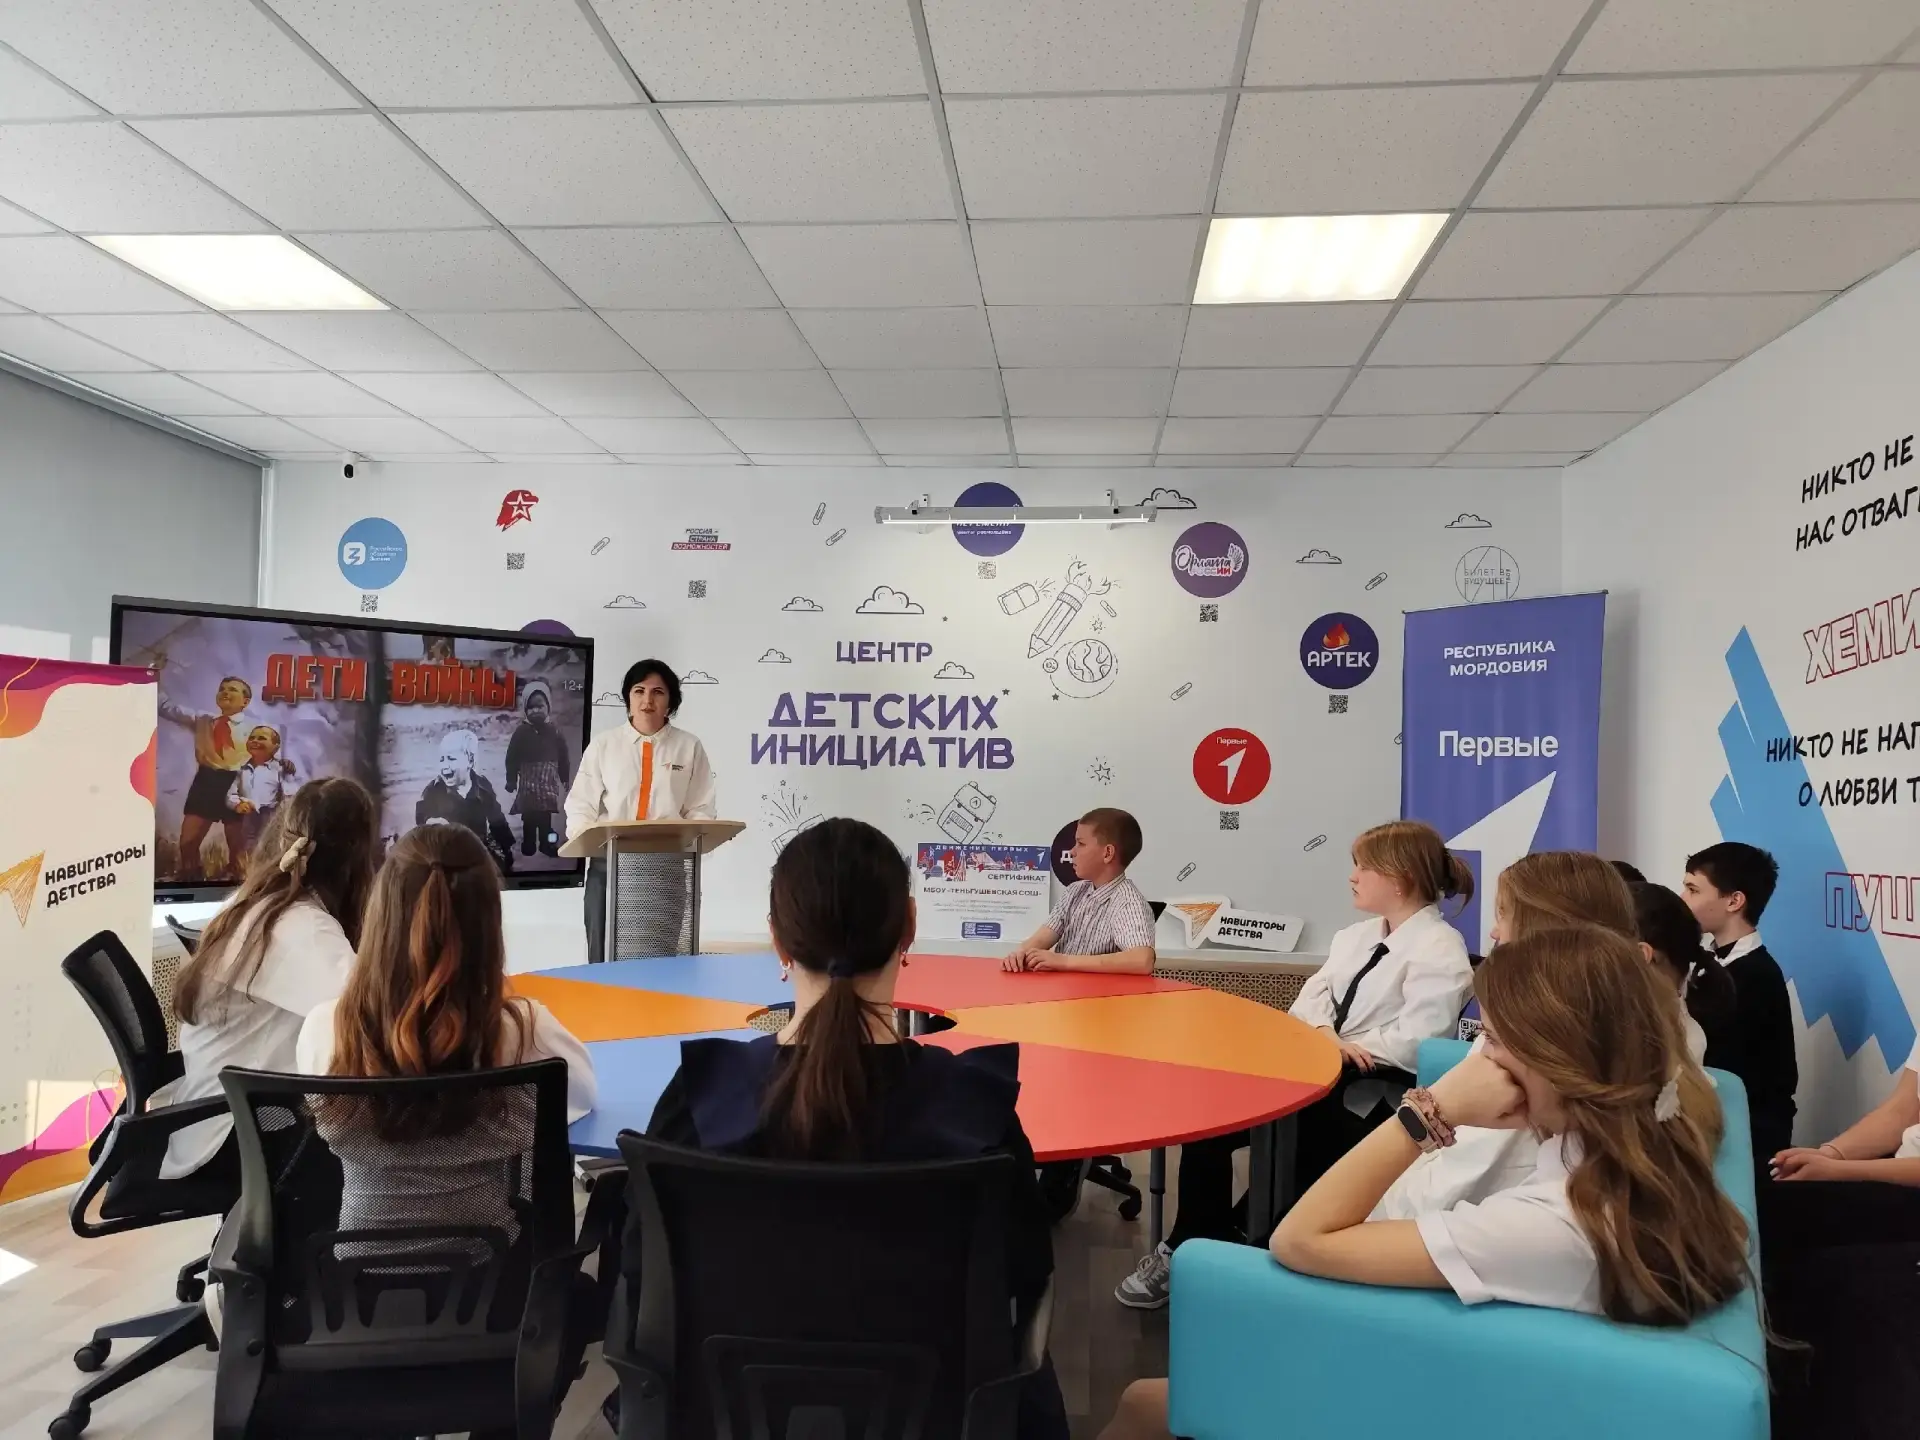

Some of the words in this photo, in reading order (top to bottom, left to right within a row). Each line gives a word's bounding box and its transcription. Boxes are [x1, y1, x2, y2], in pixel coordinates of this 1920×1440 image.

[1802, 451, 1875, 503] НИКТО
[1884, 435, 1914, 471] НЕ
[1796, 515, 1835, 551] НАС
[1842, 486, 1920, 536] ОТВАГ
[836, 640, 933, 665] ЦЕНТР
[1307, 650, 1372, 668] АРТЕК
[1443, 640, 1556, 660] РЕСПУБЛИКА
[261, 653, 368, 705] ДЕТИ
[391, 656, 517, 710] ВОЙНЫ
[1450, 659, 1548, 677] МОРДОВИЯ
[561, 679, 584, 692] 12+
[768, 691, 999, 731] ДЕТСКИХ
[751, 733, 1015, 770] ИНИЦИАТИВ
[1216, 736, 1248, 747] Первые
[1438, 730, 1560, 766] Первые
[1766, 731, 1834, 763] НИКТО
[1841, 727, 1869, 756] НЕ
[1798, 781, 1813, 807] О
[1819, 776, 1897, 807] ЛЮБВИ
[45, 844, 147, 886] НАВИГАТОРЫ
[987, 873, 1046, 882] СЕРТИФИКАТ
[46, 872, 117, 909] ДЕТСТВА
[1217, 926, 1263, 940] ДЕТСТВА
[1220, 915, 1286, 932] НАВИГАТОРЫ
